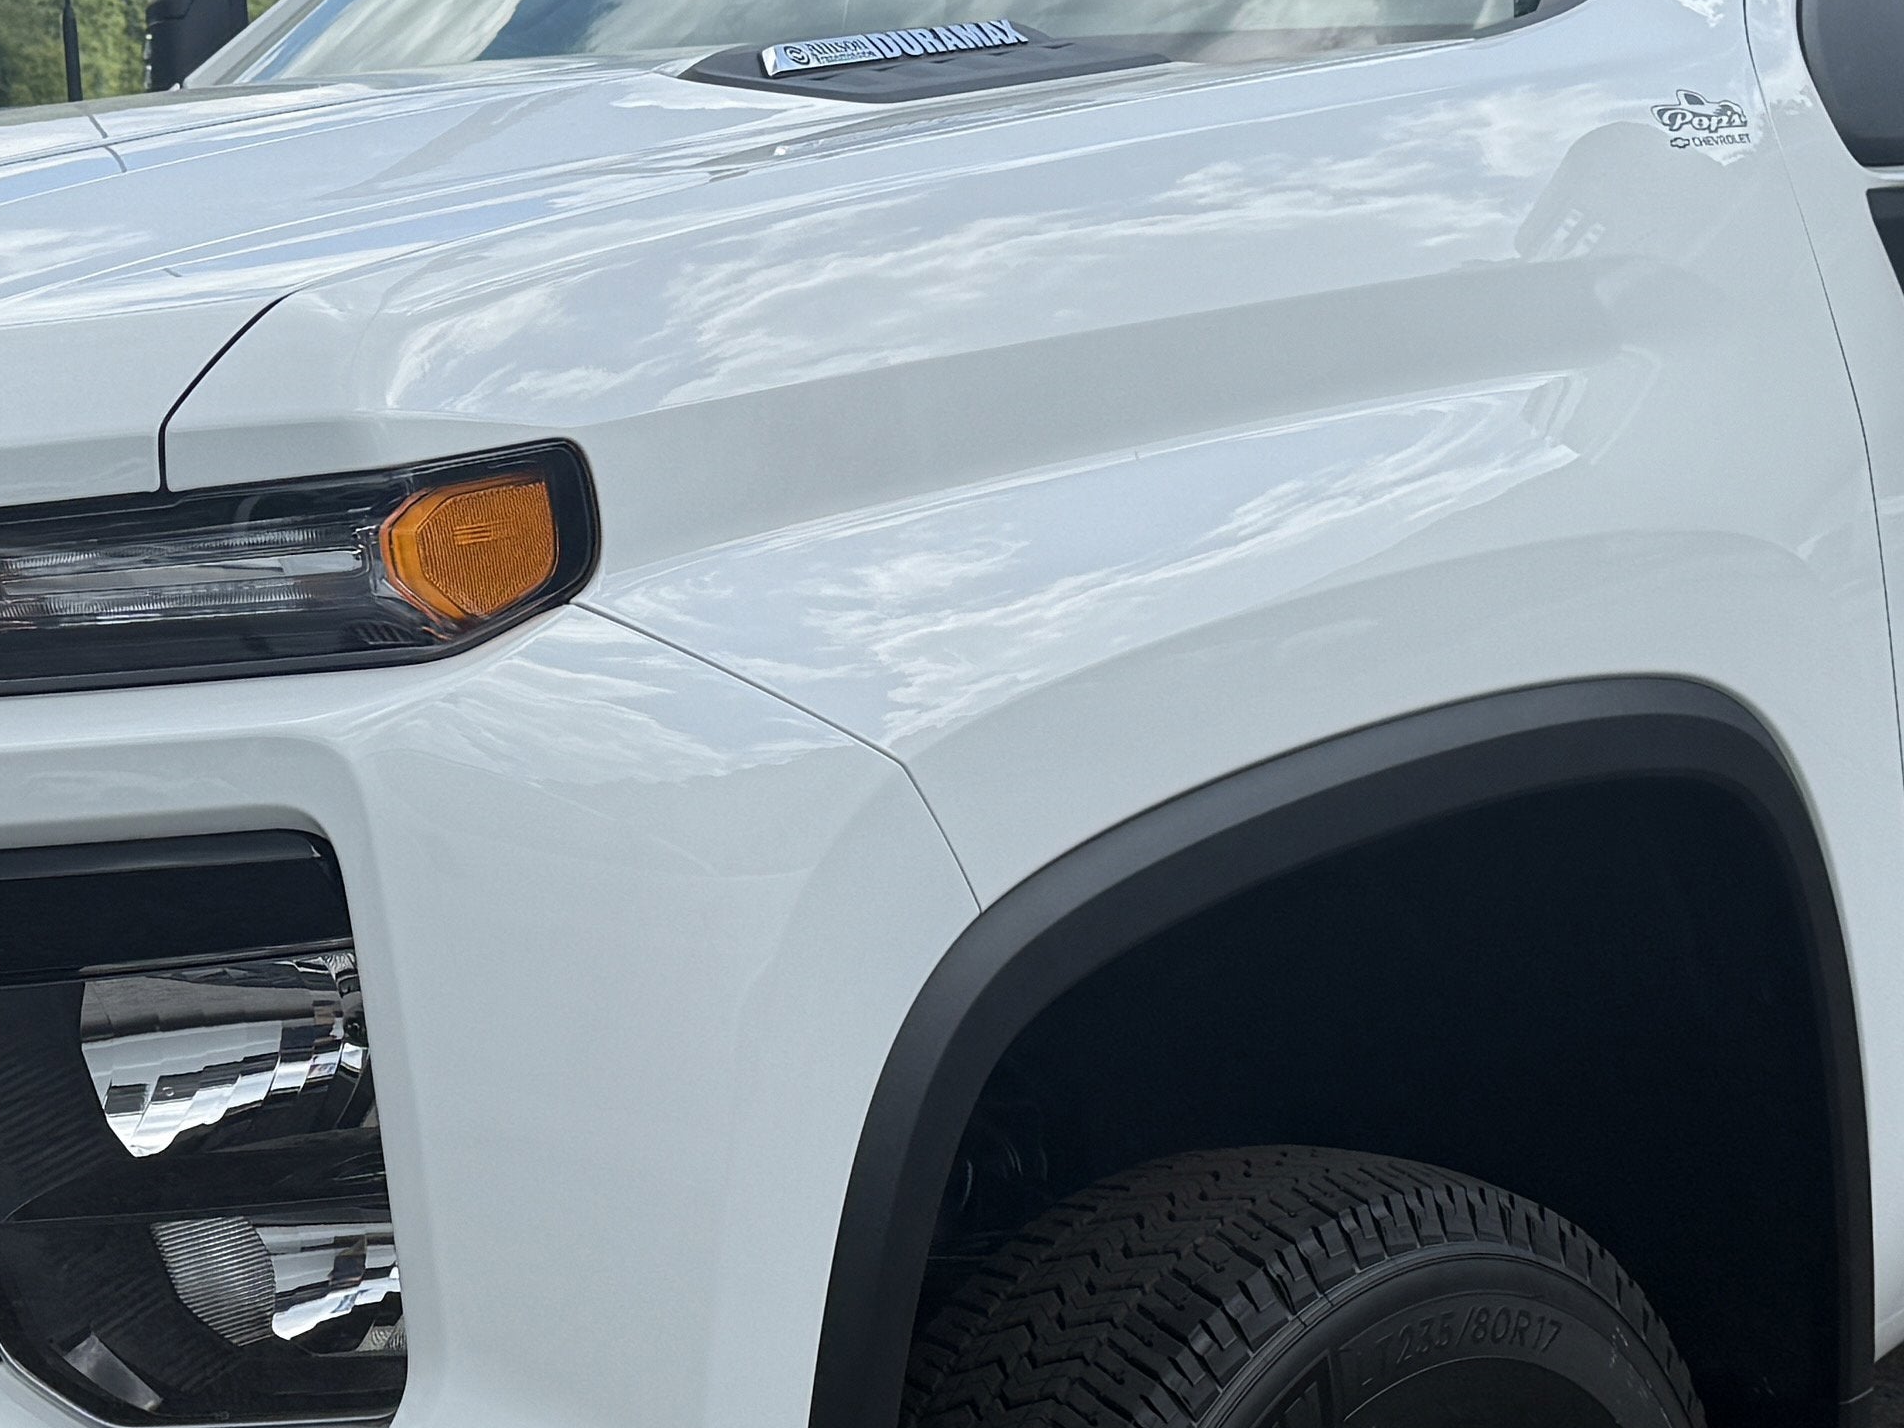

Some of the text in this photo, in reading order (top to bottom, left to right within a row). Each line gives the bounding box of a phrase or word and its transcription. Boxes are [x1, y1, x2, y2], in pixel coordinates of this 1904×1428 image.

[871, 18, 1029, 60] DURAMAX
[1661, 108, 1747, 133] Pop's
[1692, 133, 1751, 147] CHEVROLET
